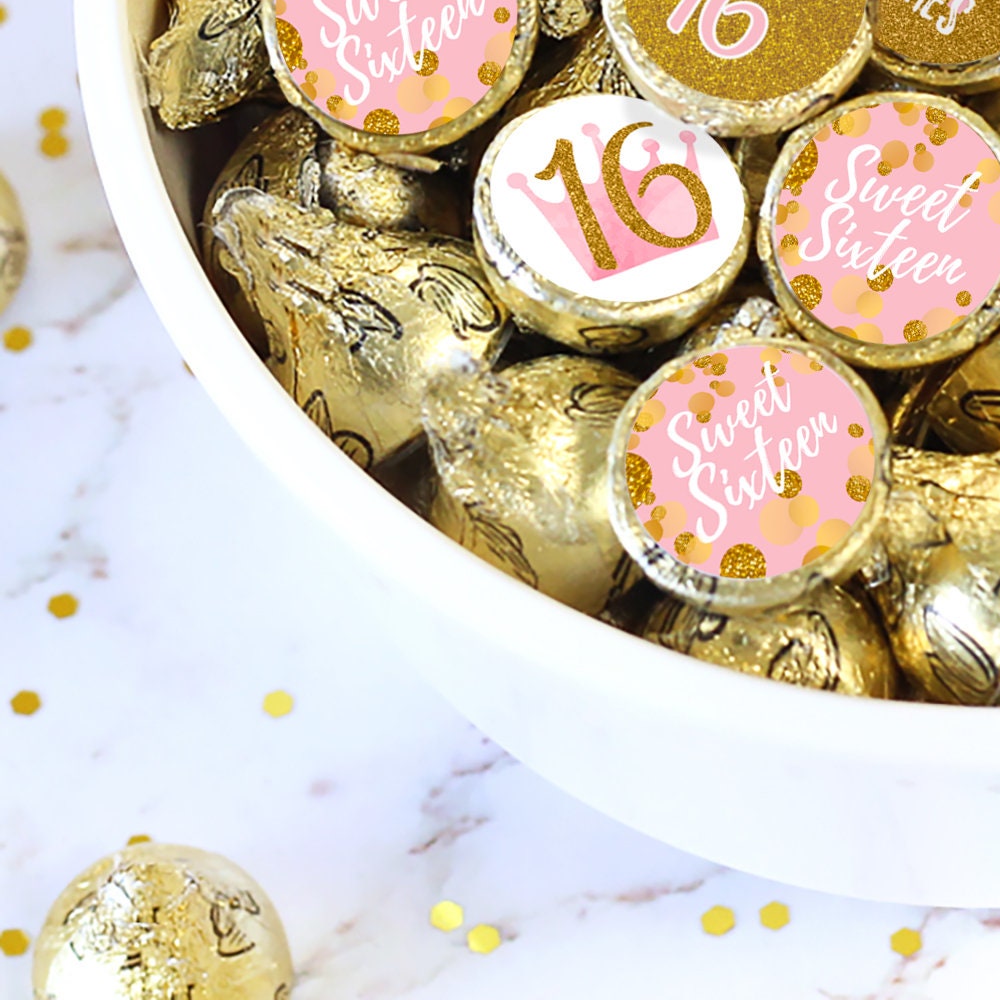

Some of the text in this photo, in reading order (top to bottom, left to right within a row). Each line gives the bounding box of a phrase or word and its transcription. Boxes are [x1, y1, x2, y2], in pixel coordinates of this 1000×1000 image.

[534, 121, 713, 270] 16
[798, 202, 967, 286] Sixteen
[825, 143, 982, 233] Sweet
[667, 361, 793, 479] Sweet
[688, 412, 838, 543] Sixteen
